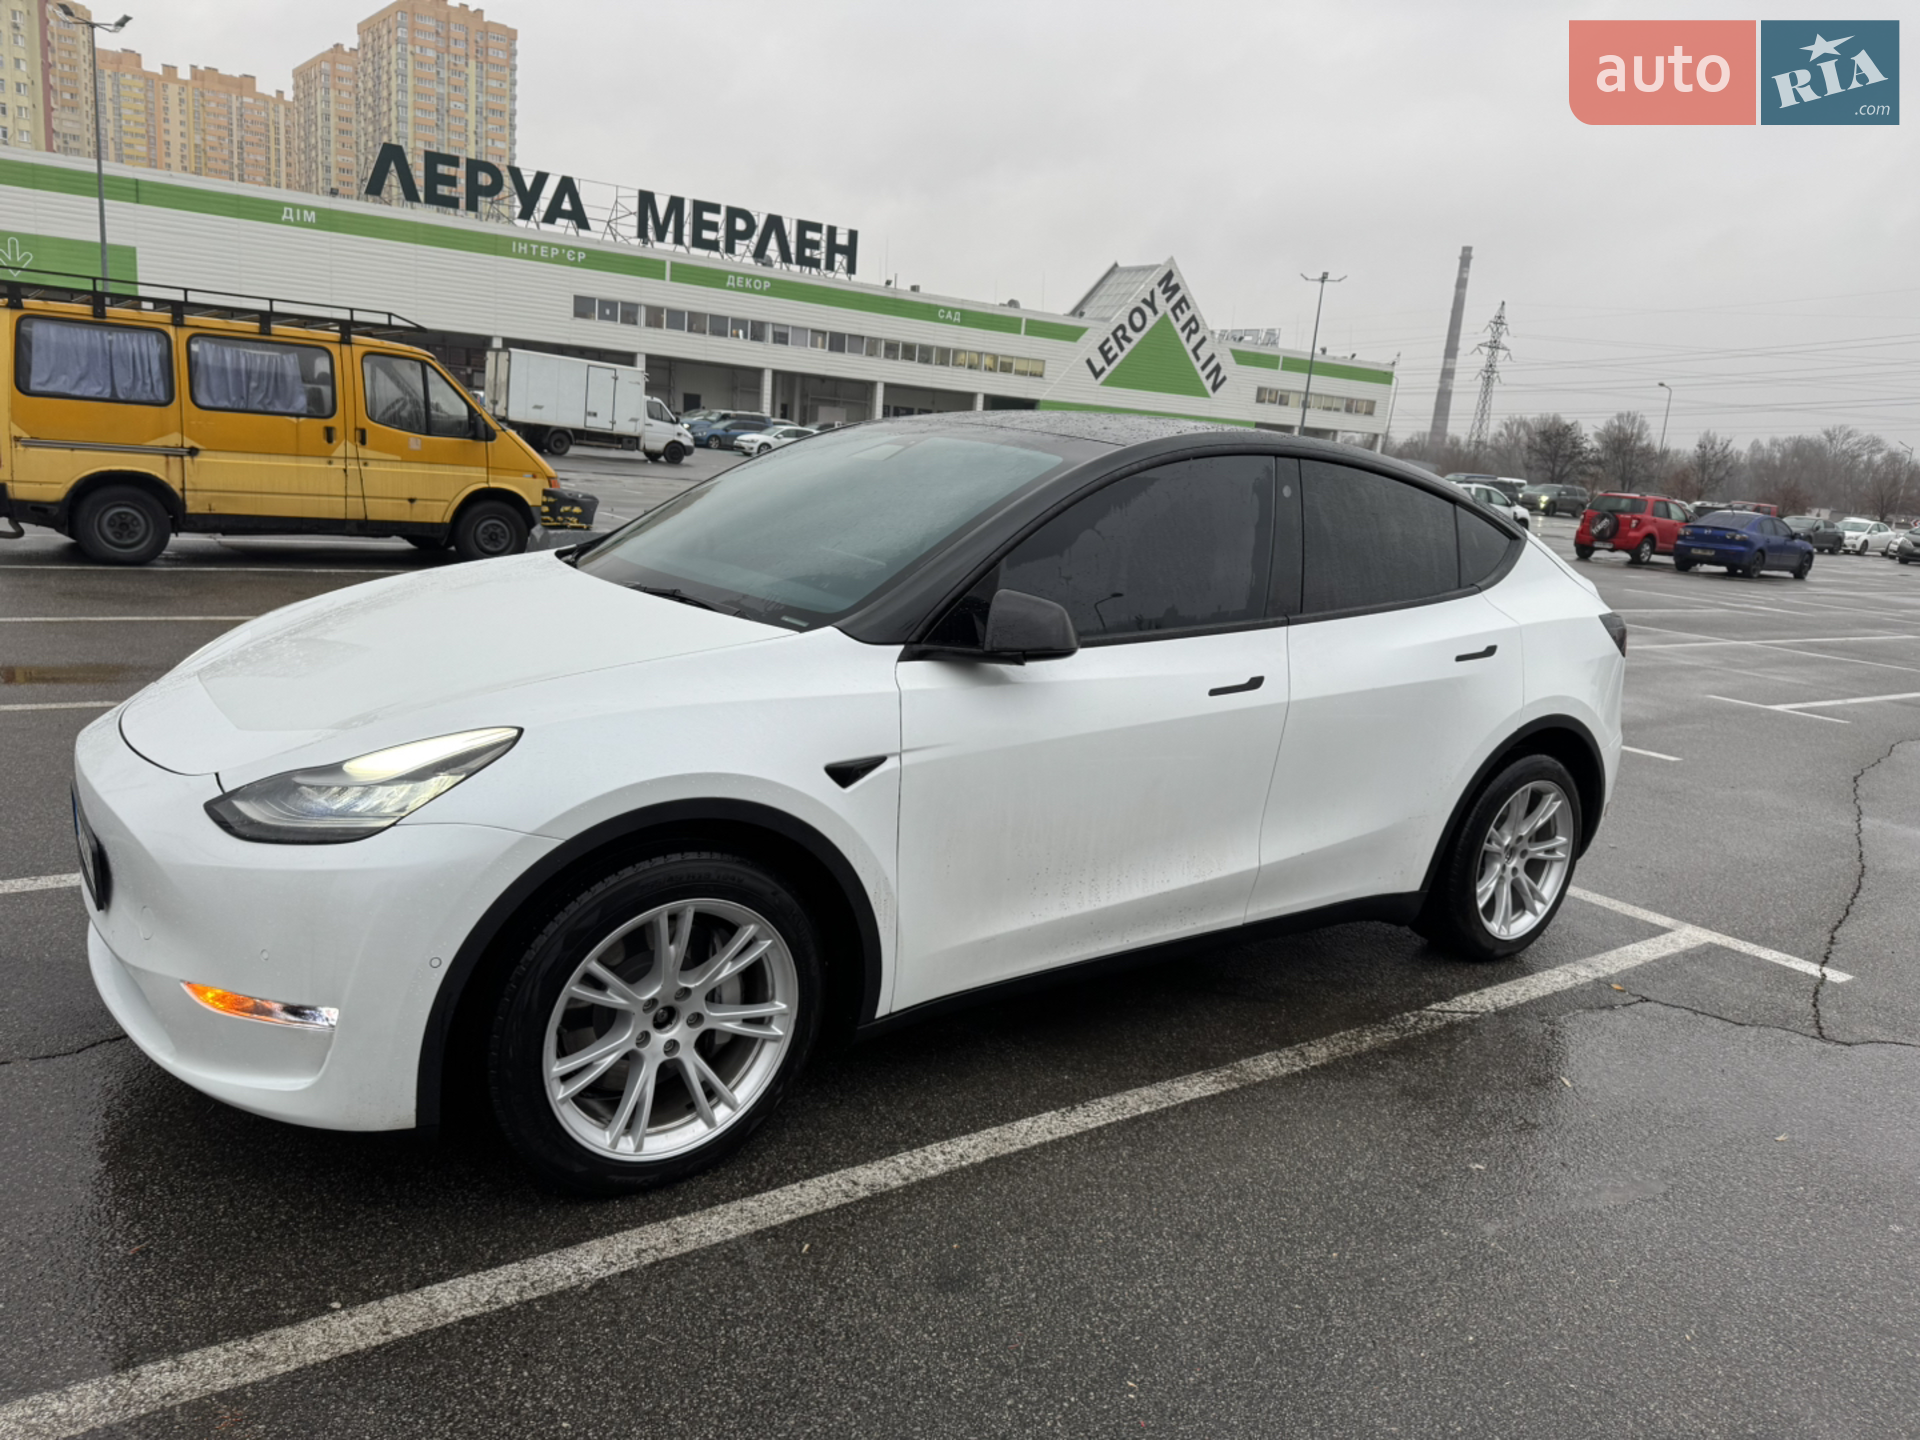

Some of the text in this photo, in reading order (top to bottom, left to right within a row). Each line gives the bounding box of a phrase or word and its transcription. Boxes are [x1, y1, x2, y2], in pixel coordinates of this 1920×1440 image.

[282, 206, 316, 223] ДІМ
[364, 142, 859, 275] ЛЕРУА МЕРЛЕН
[512, 241, 586, 263] ІНТЕР'ЄР
[726, 274, 771, 291] ДЕКОР
[938, 308, 961, 323] САД
[1085, 269, 1227, 394] LEROY MERLIN
